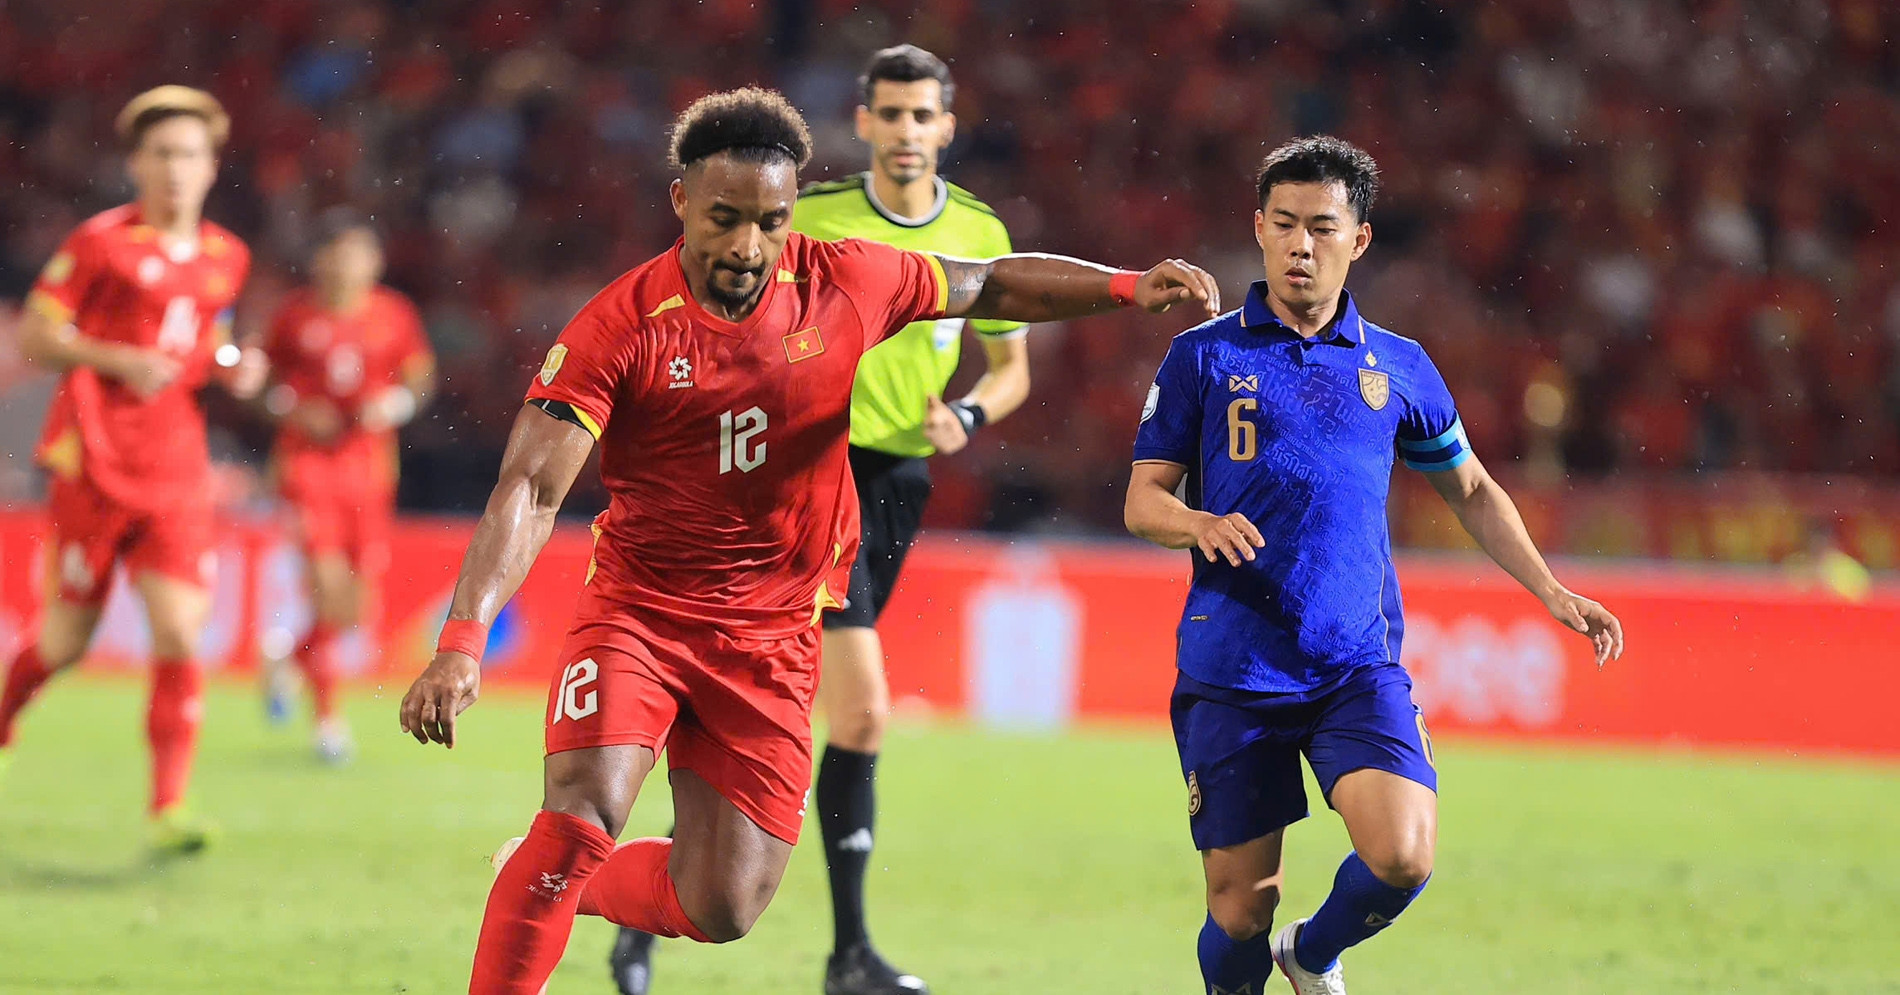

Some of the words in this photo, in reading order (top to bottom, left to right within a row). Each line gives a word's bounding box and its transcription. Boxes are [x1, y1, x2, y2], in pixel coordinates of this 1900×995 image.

[719, 406, 768, 474] 12
[1227, 398, 1257, 461] 6
[553, 657, 599, 724] 12
